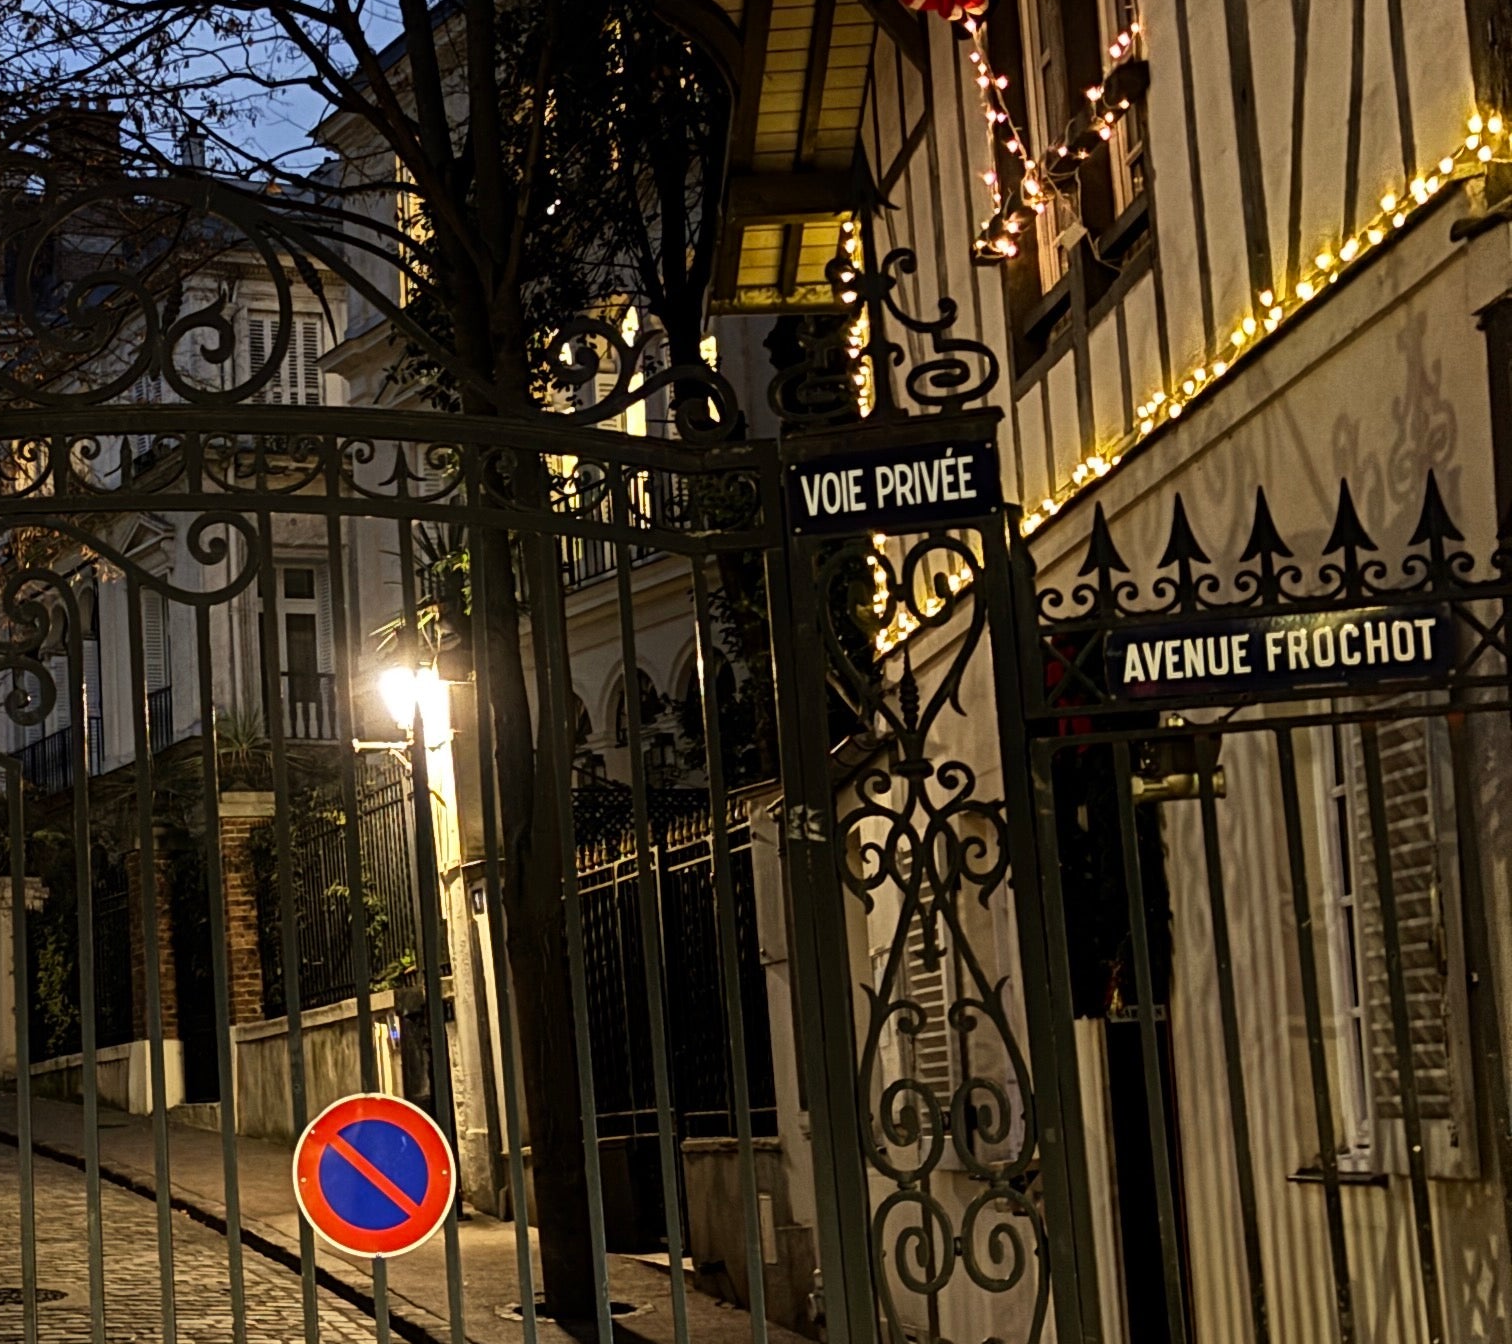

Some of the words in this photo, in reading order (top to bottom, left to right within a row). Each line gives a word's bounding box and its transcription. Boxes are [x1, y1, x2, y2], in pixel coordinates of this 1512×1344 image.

[800, 468, 867, 517] VOIE
[875, 446, 978, 509] PRIVÉE
[1123, 633, 1252, 683] AVENUE
[1266, 617, 1437, 672] FROCHOT
